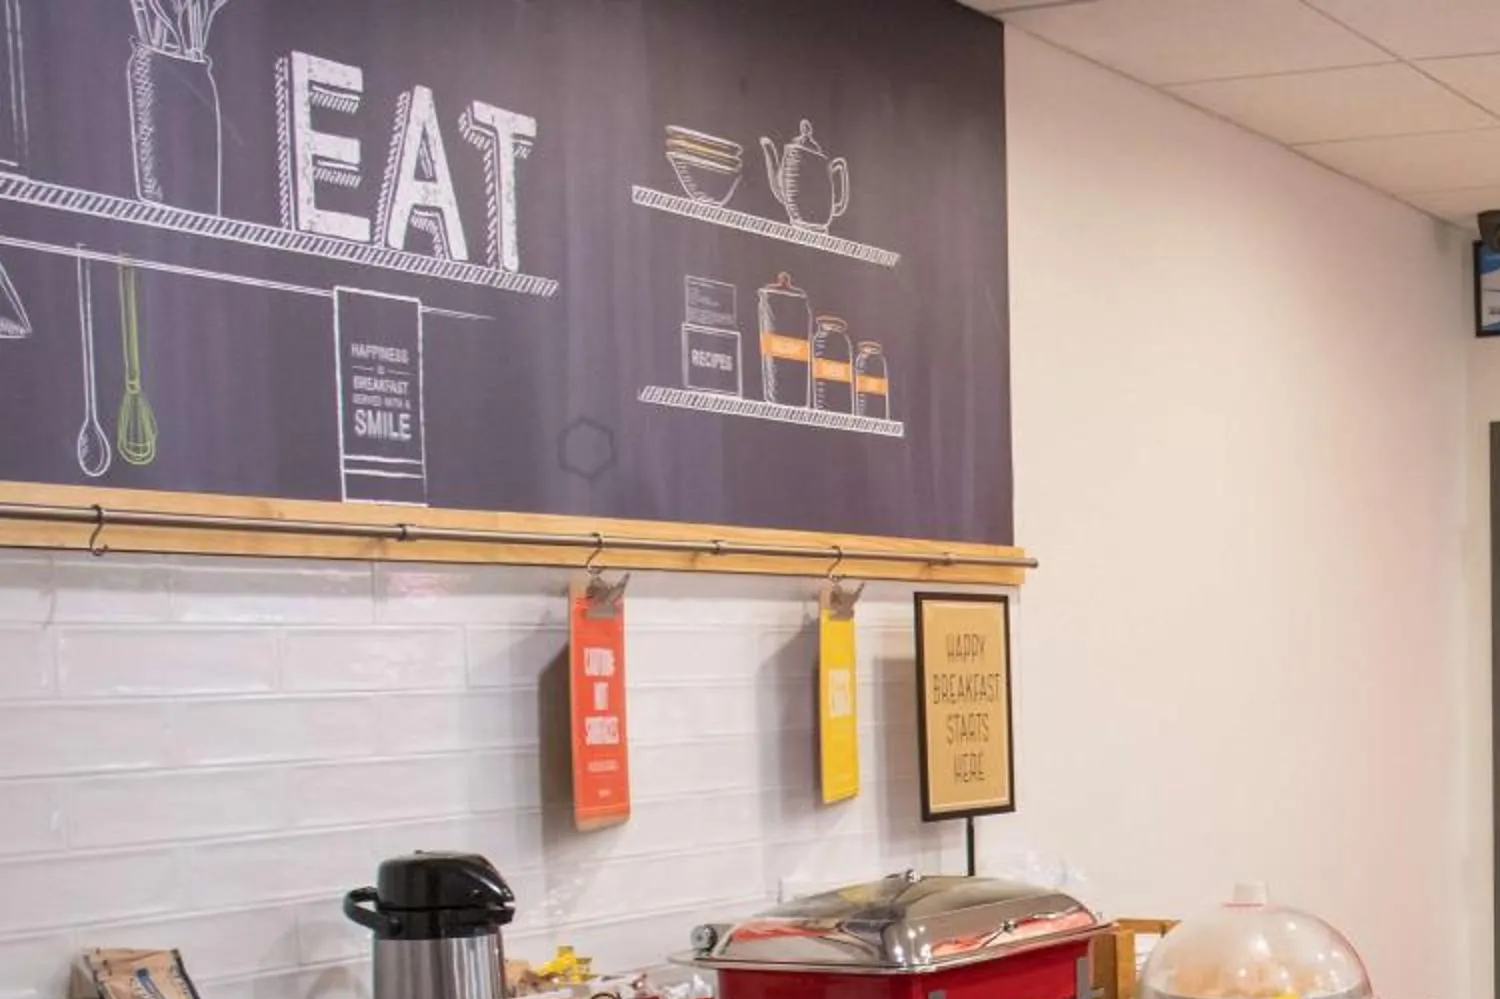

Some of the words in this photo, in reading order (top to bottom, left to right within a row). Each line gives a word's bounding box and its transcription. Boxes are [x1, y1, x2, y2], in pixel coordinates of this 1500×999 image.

[275, 50, 537, 273] EAT
[351, 343, 410, 364] HAPPINESS
[353, 375, 409, 395] BREAKFAST
[354, 409, 412, 440] SMILE
[946, 632, 987, 663] HAPPY
[932, 672, 1001, 705] BREAKFAST
[946, 712, 990, 746] STARTS
[953, 751, 986, 784] HERE
